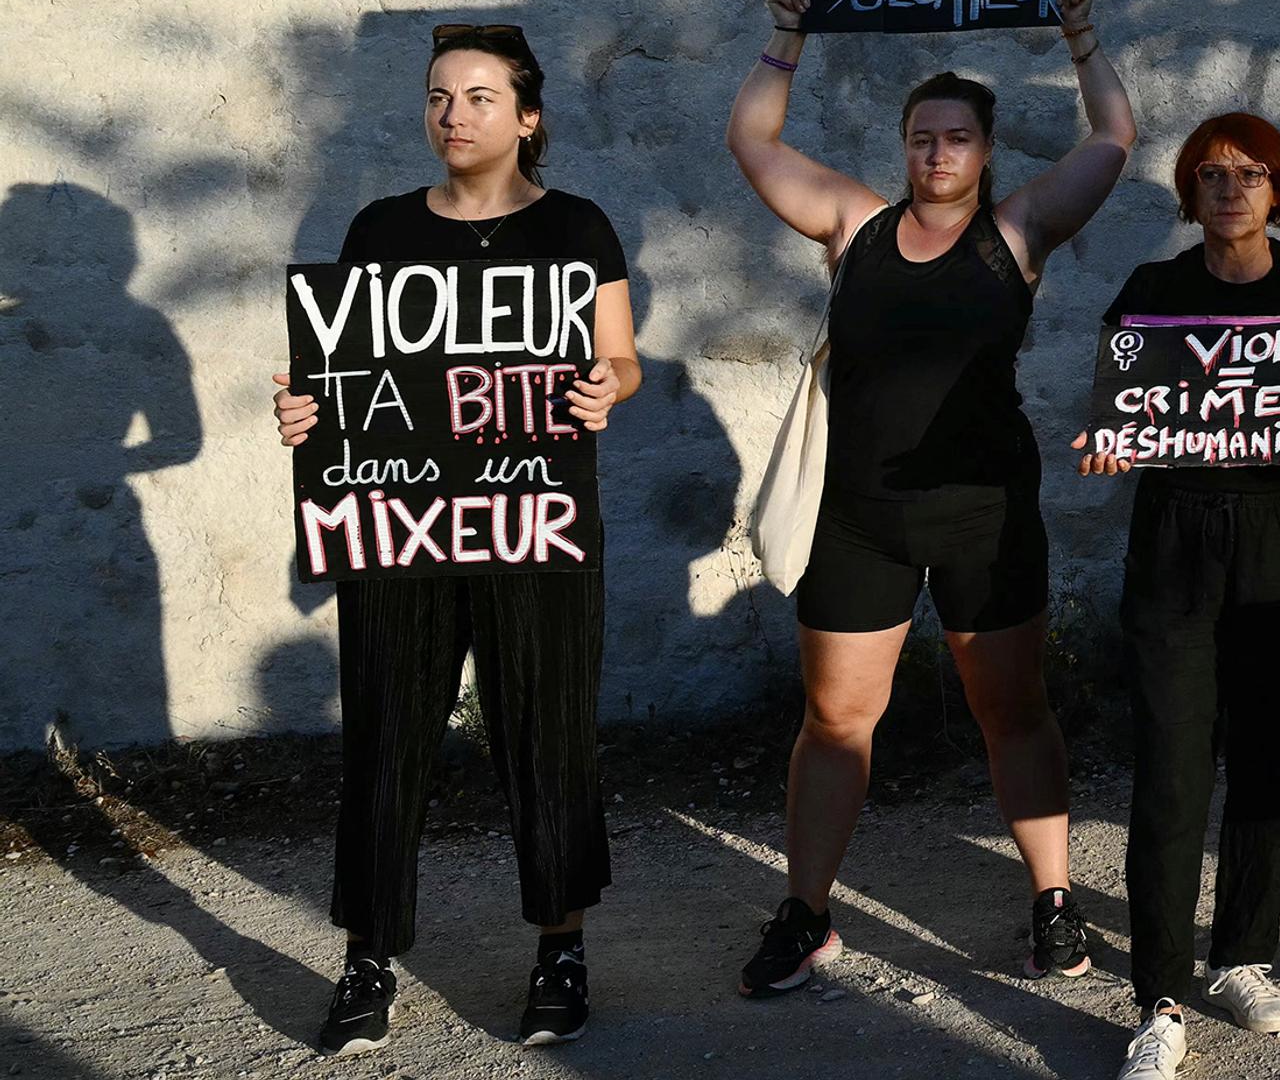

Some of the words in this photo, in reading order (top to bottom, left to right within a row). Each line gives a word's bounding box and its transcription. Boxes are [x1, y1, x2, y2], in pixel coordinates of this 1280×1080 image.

[291, 261, 597, 359] VIOLEUR
[307, 369, 414, 431] TA
[446, 362, 579, 434] BITE
[323, 439, 440, 486] dans
[475, 456, 562, 486] un
[301, 489, 587, 576] MIXEUR
